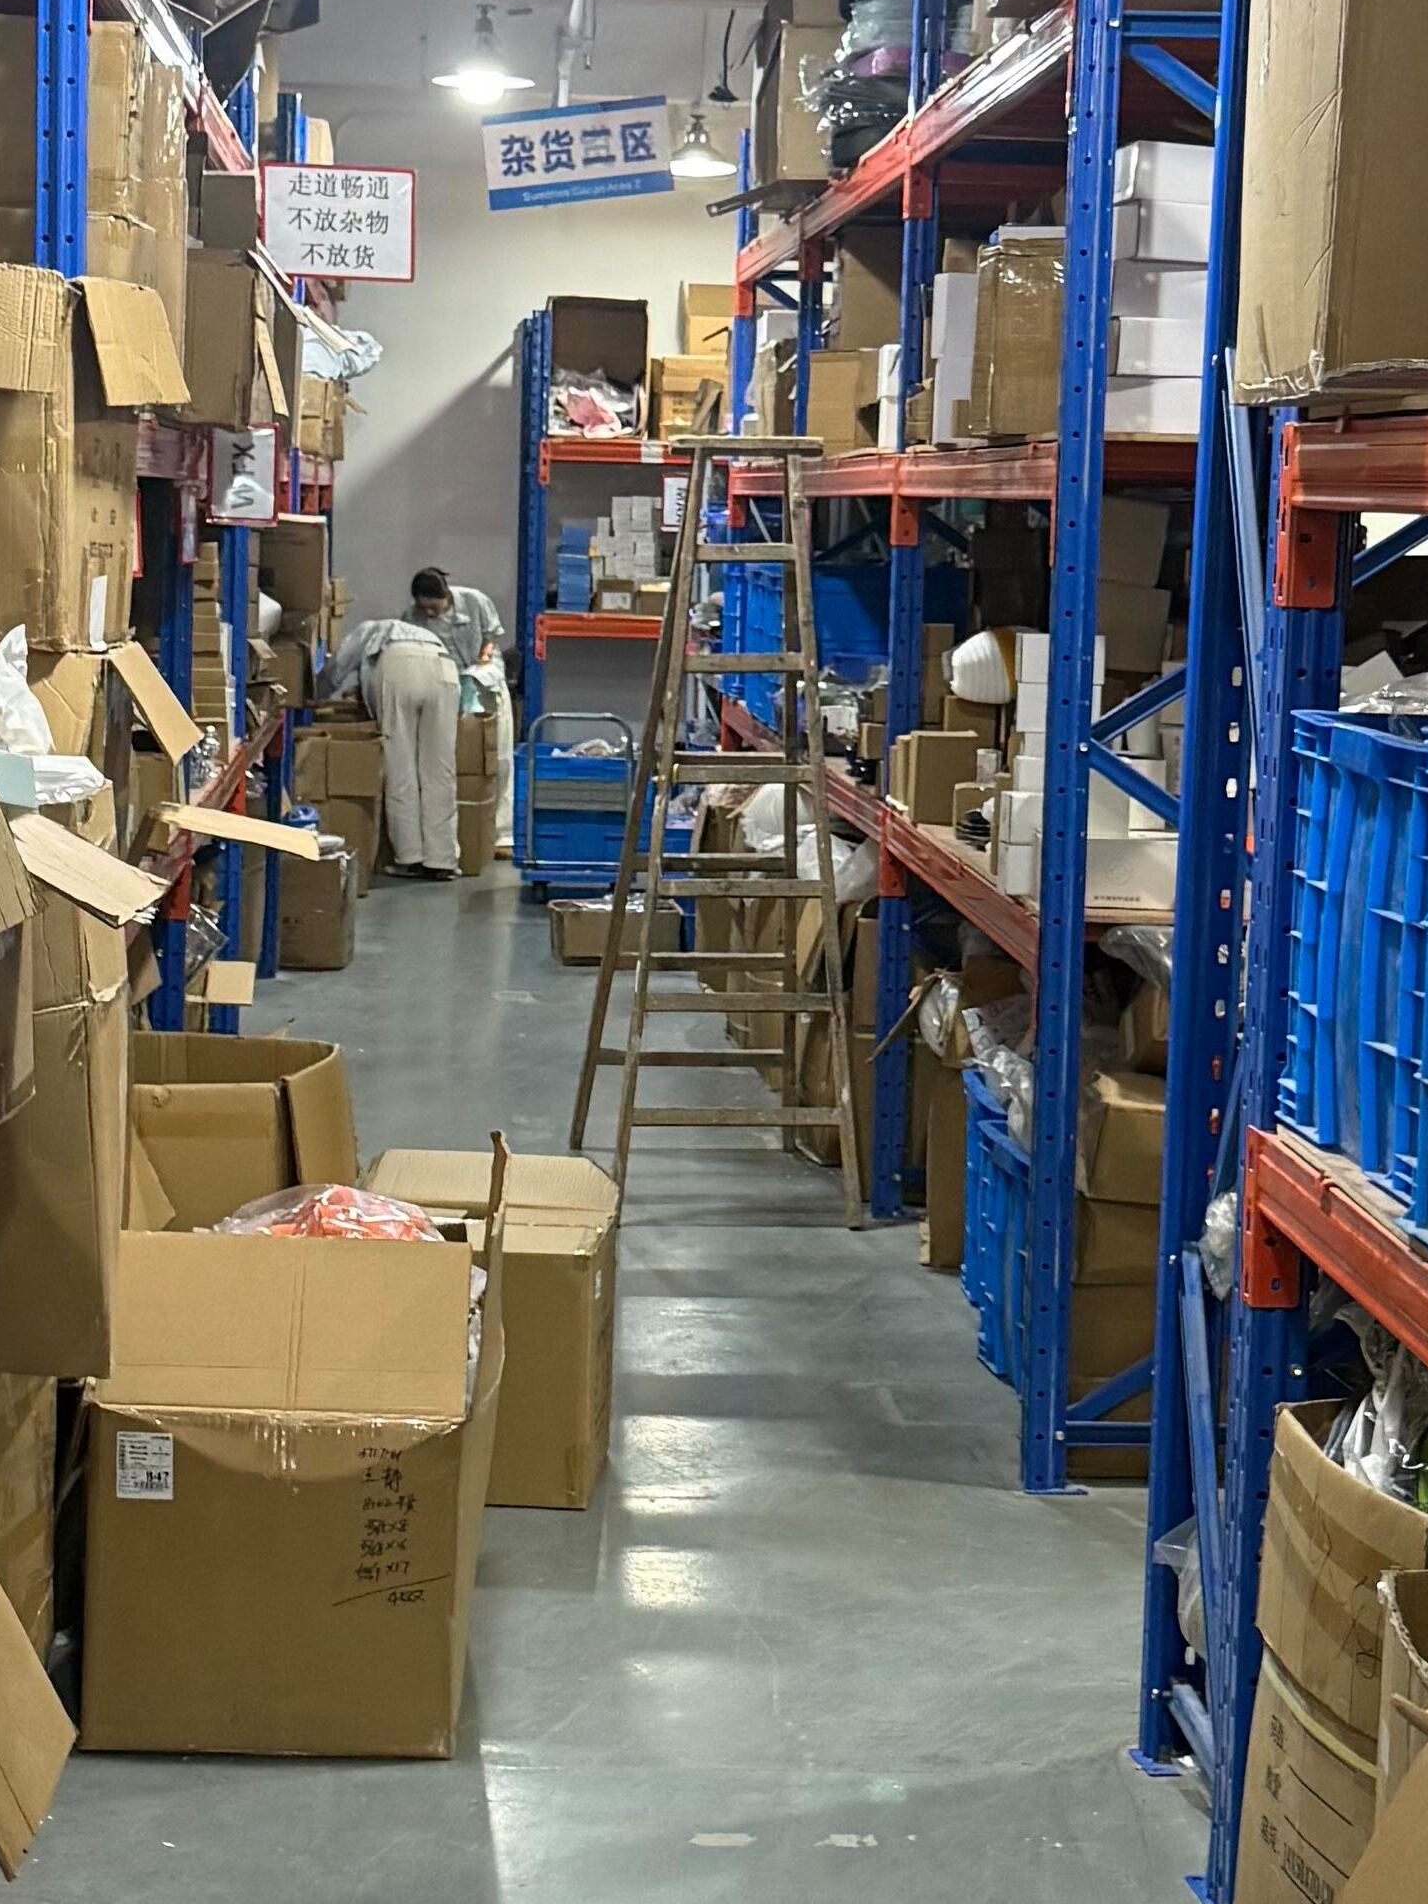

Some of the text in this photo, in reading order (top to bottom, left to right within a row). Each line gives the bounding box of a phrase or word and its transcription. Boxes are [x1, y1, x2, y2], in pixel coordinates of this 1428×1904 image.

[288, 172, 390, 200] 走道畅通
[288, 207, 390, 235] 不放杂物
[300, 242, 375, 270] 不放货
